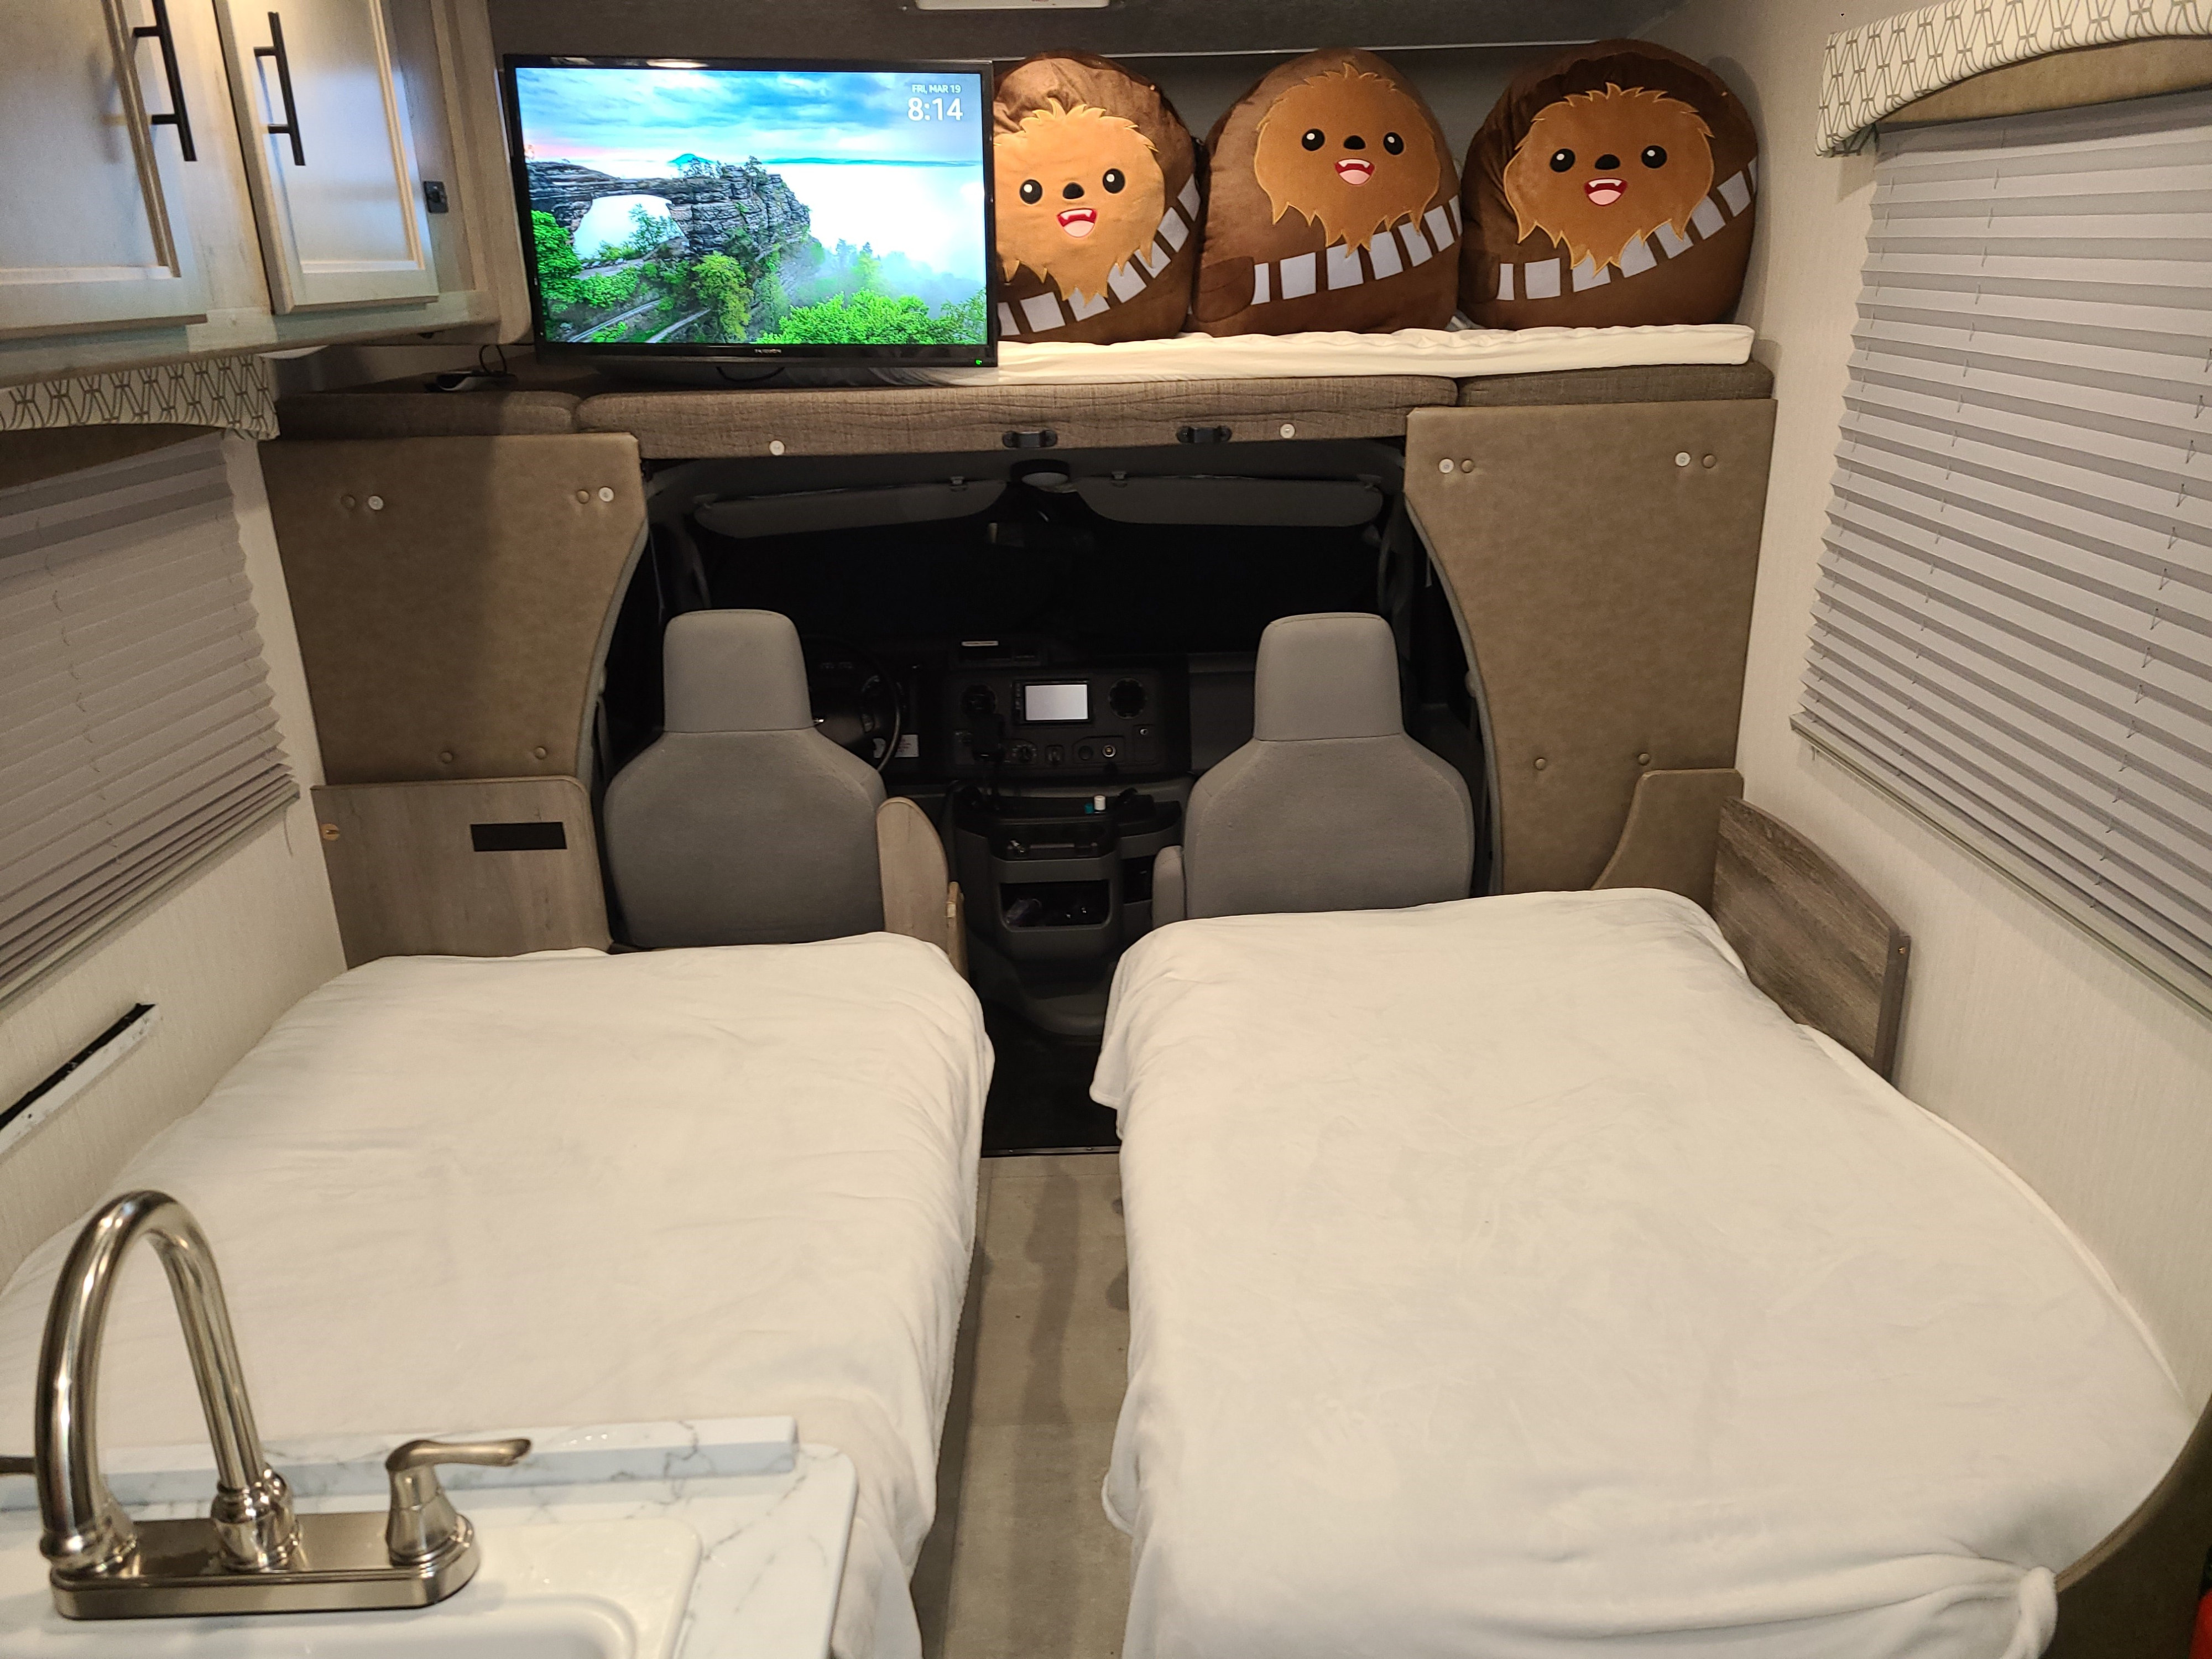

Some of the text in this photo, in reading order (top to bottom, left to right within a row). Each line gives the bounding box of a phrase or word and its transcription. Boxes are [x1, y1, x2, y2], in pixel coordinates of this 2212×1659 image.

[912, 84, 961, 94] FRI, MAR 19
[907, 97, 963, 121] 8:14
